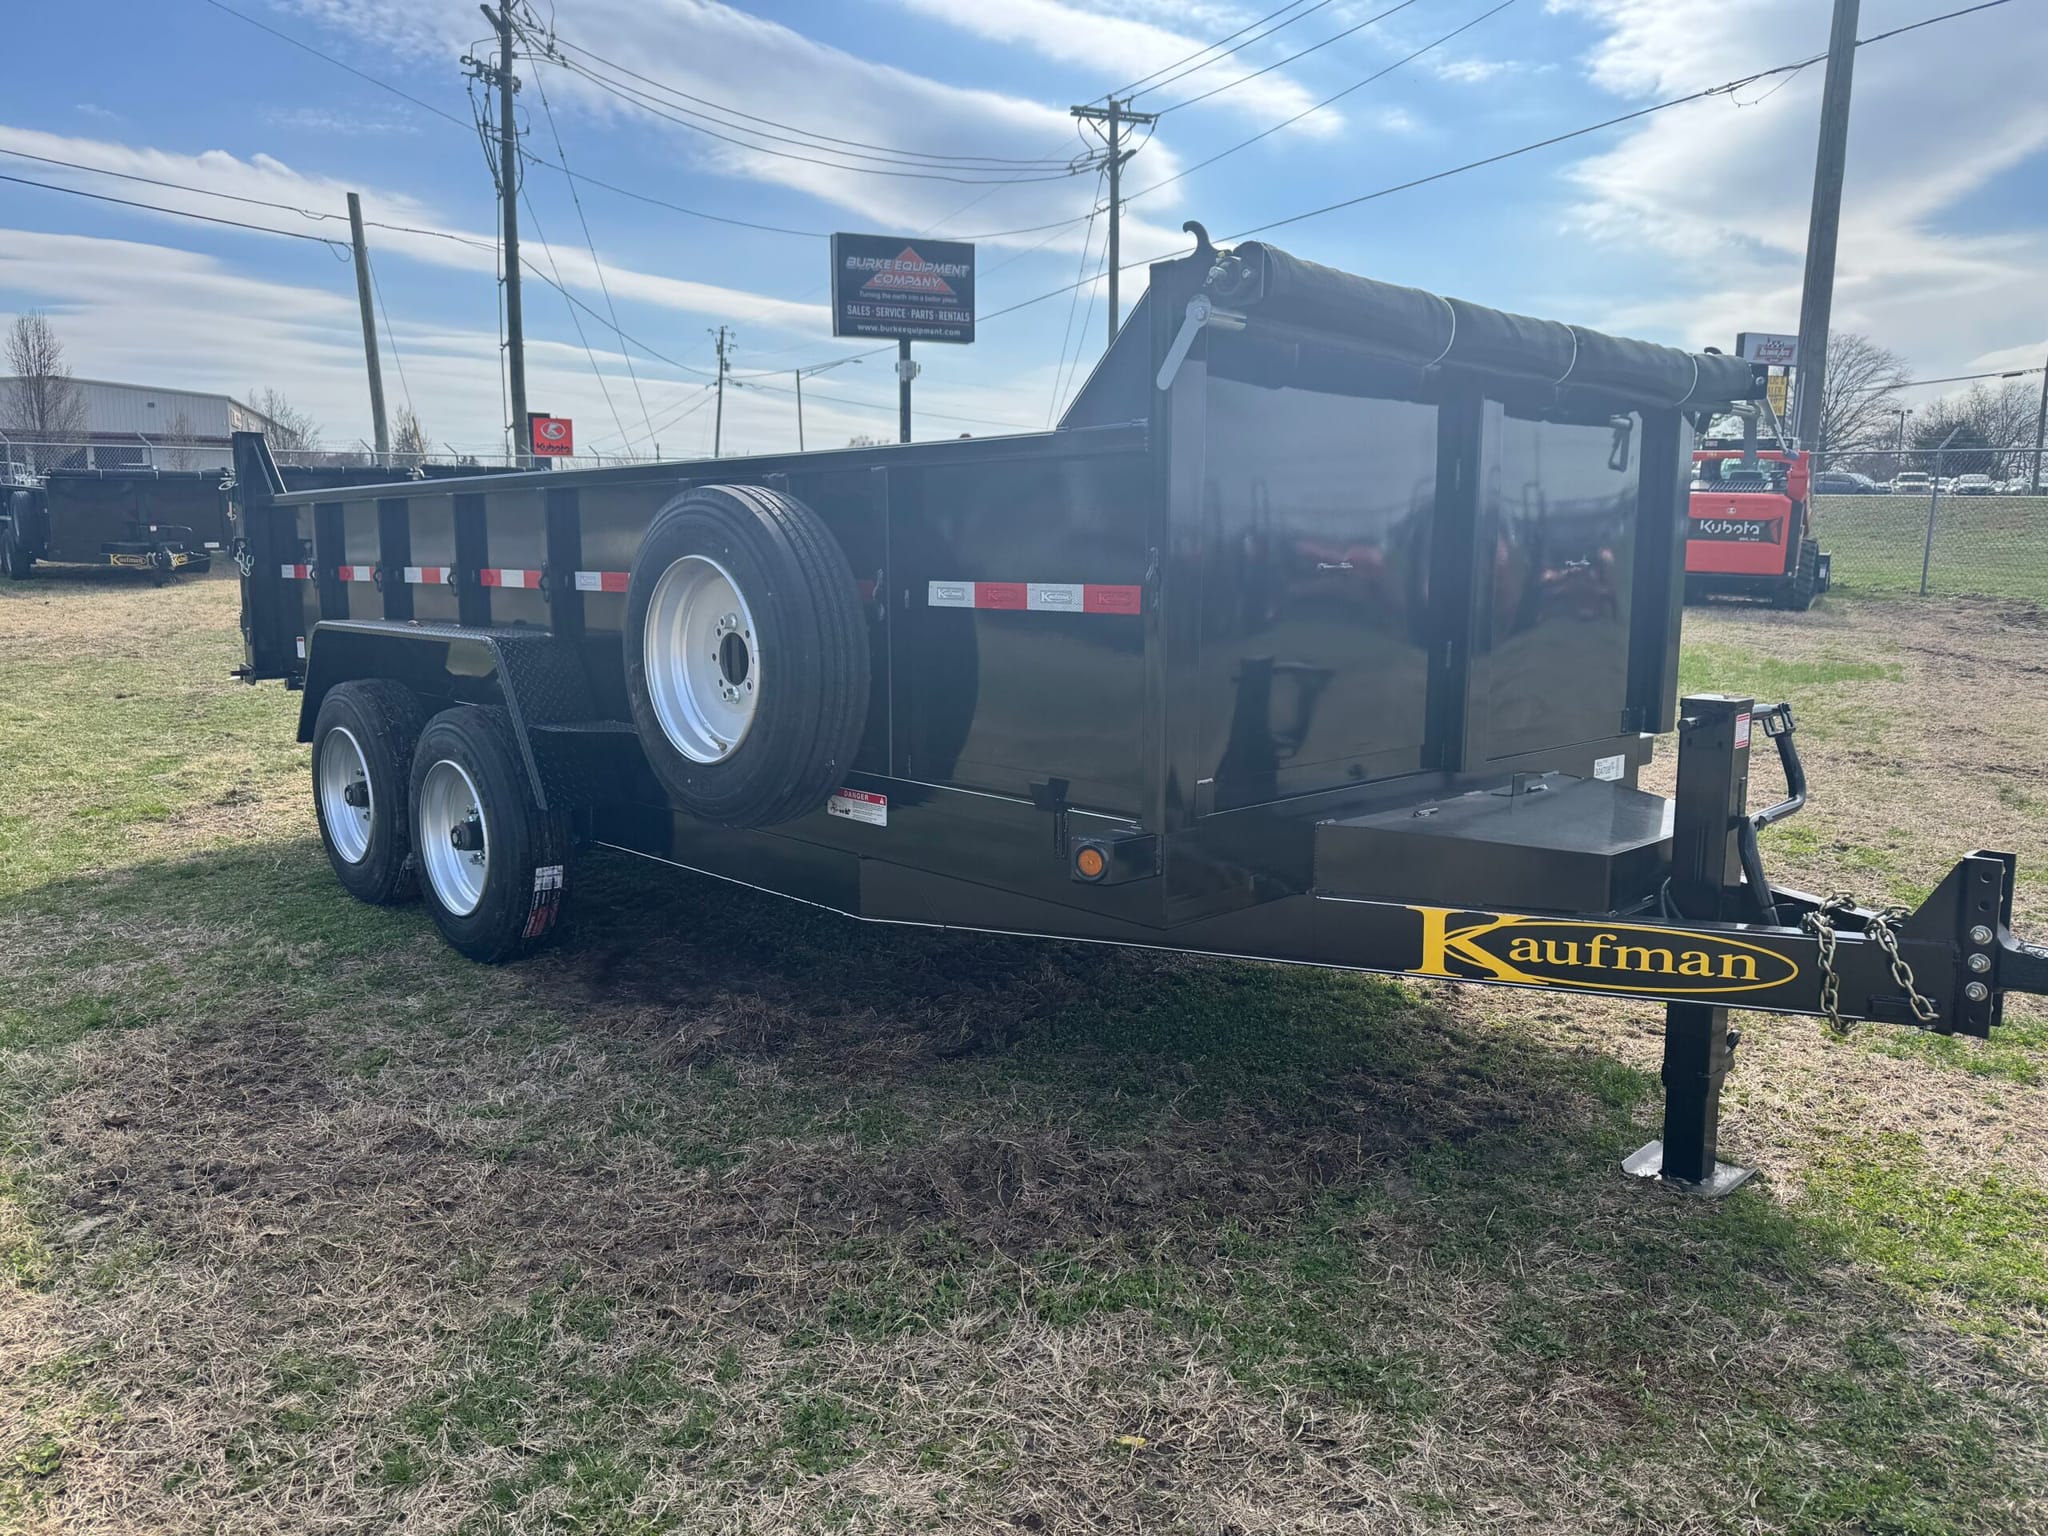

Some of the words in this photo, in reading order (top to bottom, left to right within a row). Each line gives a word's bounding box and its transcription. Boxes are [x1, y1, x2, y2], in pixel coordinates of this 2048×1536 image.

[846, 256, 892, 270] BURKE
[894, 260, 970, 277] EQUIPMENT
[874, 274, 940, 288] COMPANY
[847, 304, 871, 316] SALES
[875, 306, 906, 319] SERVICE
[911, 309, 934, 320] PARTS
[938, 311, 970, 322] RENTALS
[857, 324, 961, 336] www.burkeequipment.com
[536, 442, 570, 452] Kubota
[1700, 519, 1759, 534] Kubota
[844, 790, 869, 800] DANGER
[1405, 905, 1760, 985] Kaufman
